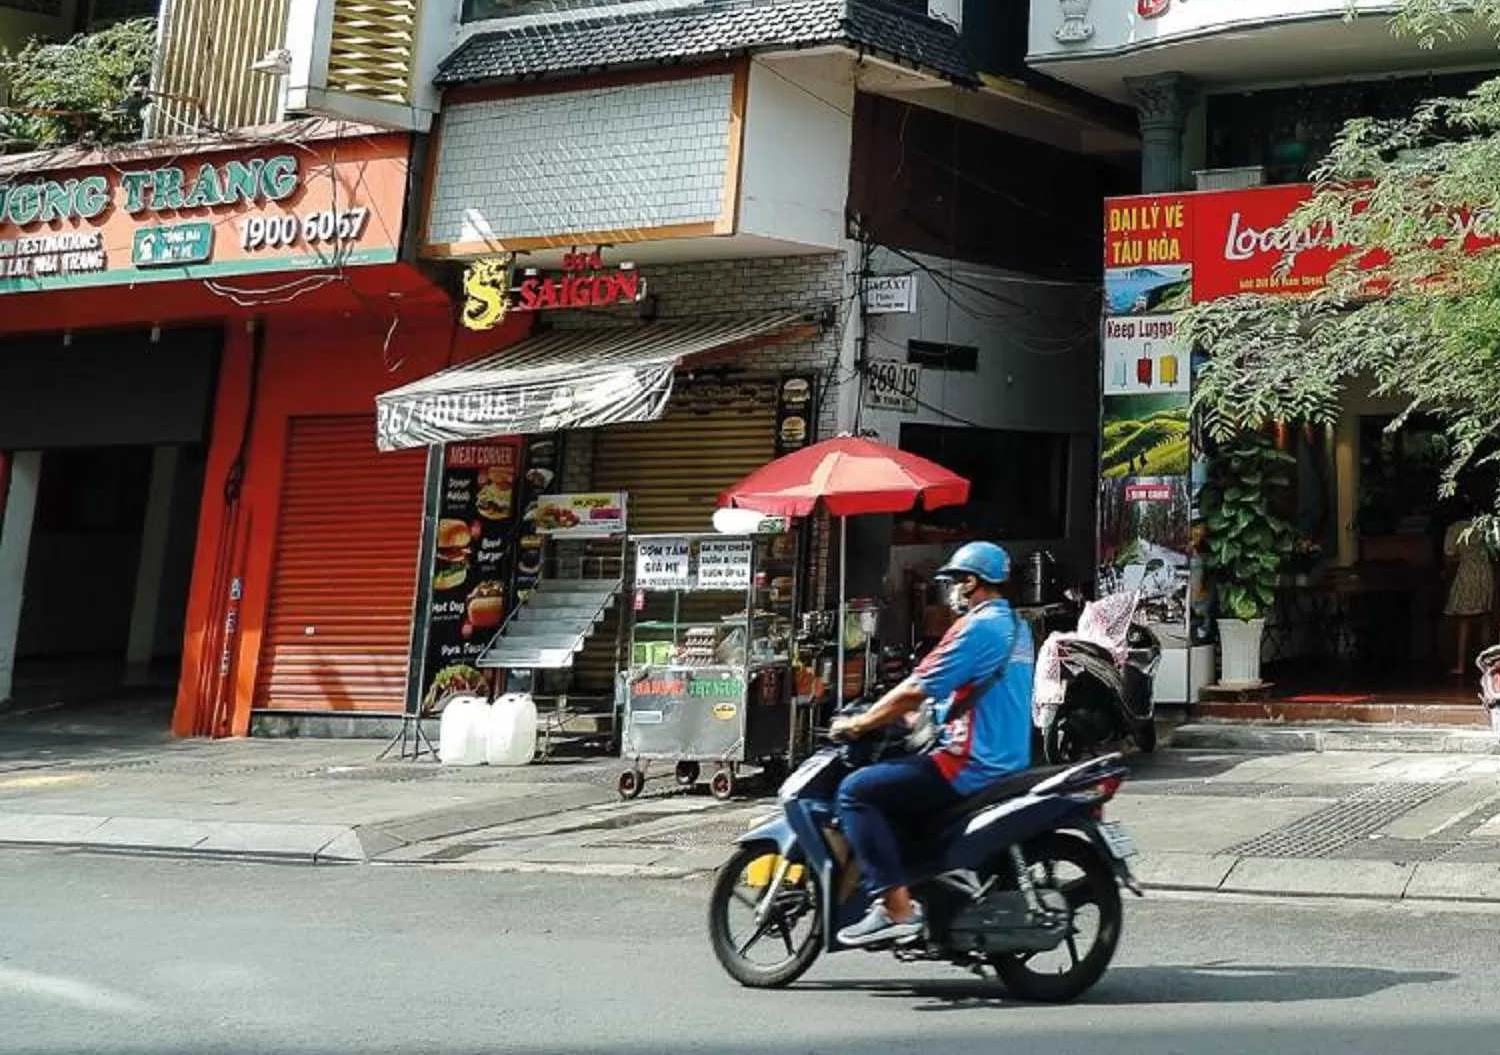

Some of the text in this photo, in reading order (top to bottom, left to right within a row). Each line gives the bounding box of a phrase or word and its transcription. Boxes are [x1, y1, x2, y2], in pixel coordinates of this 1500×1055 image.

[121, 155, 299, 213] TRANG
[240, 208, 368, 246] 1900 6067
[1109, 207, 1137, 232] ĐẠI
[519, 270, 639, 310] SAIGON
[1107, 321, 1135, 340] Keep
[449, 446, 476, 464] MEAT
